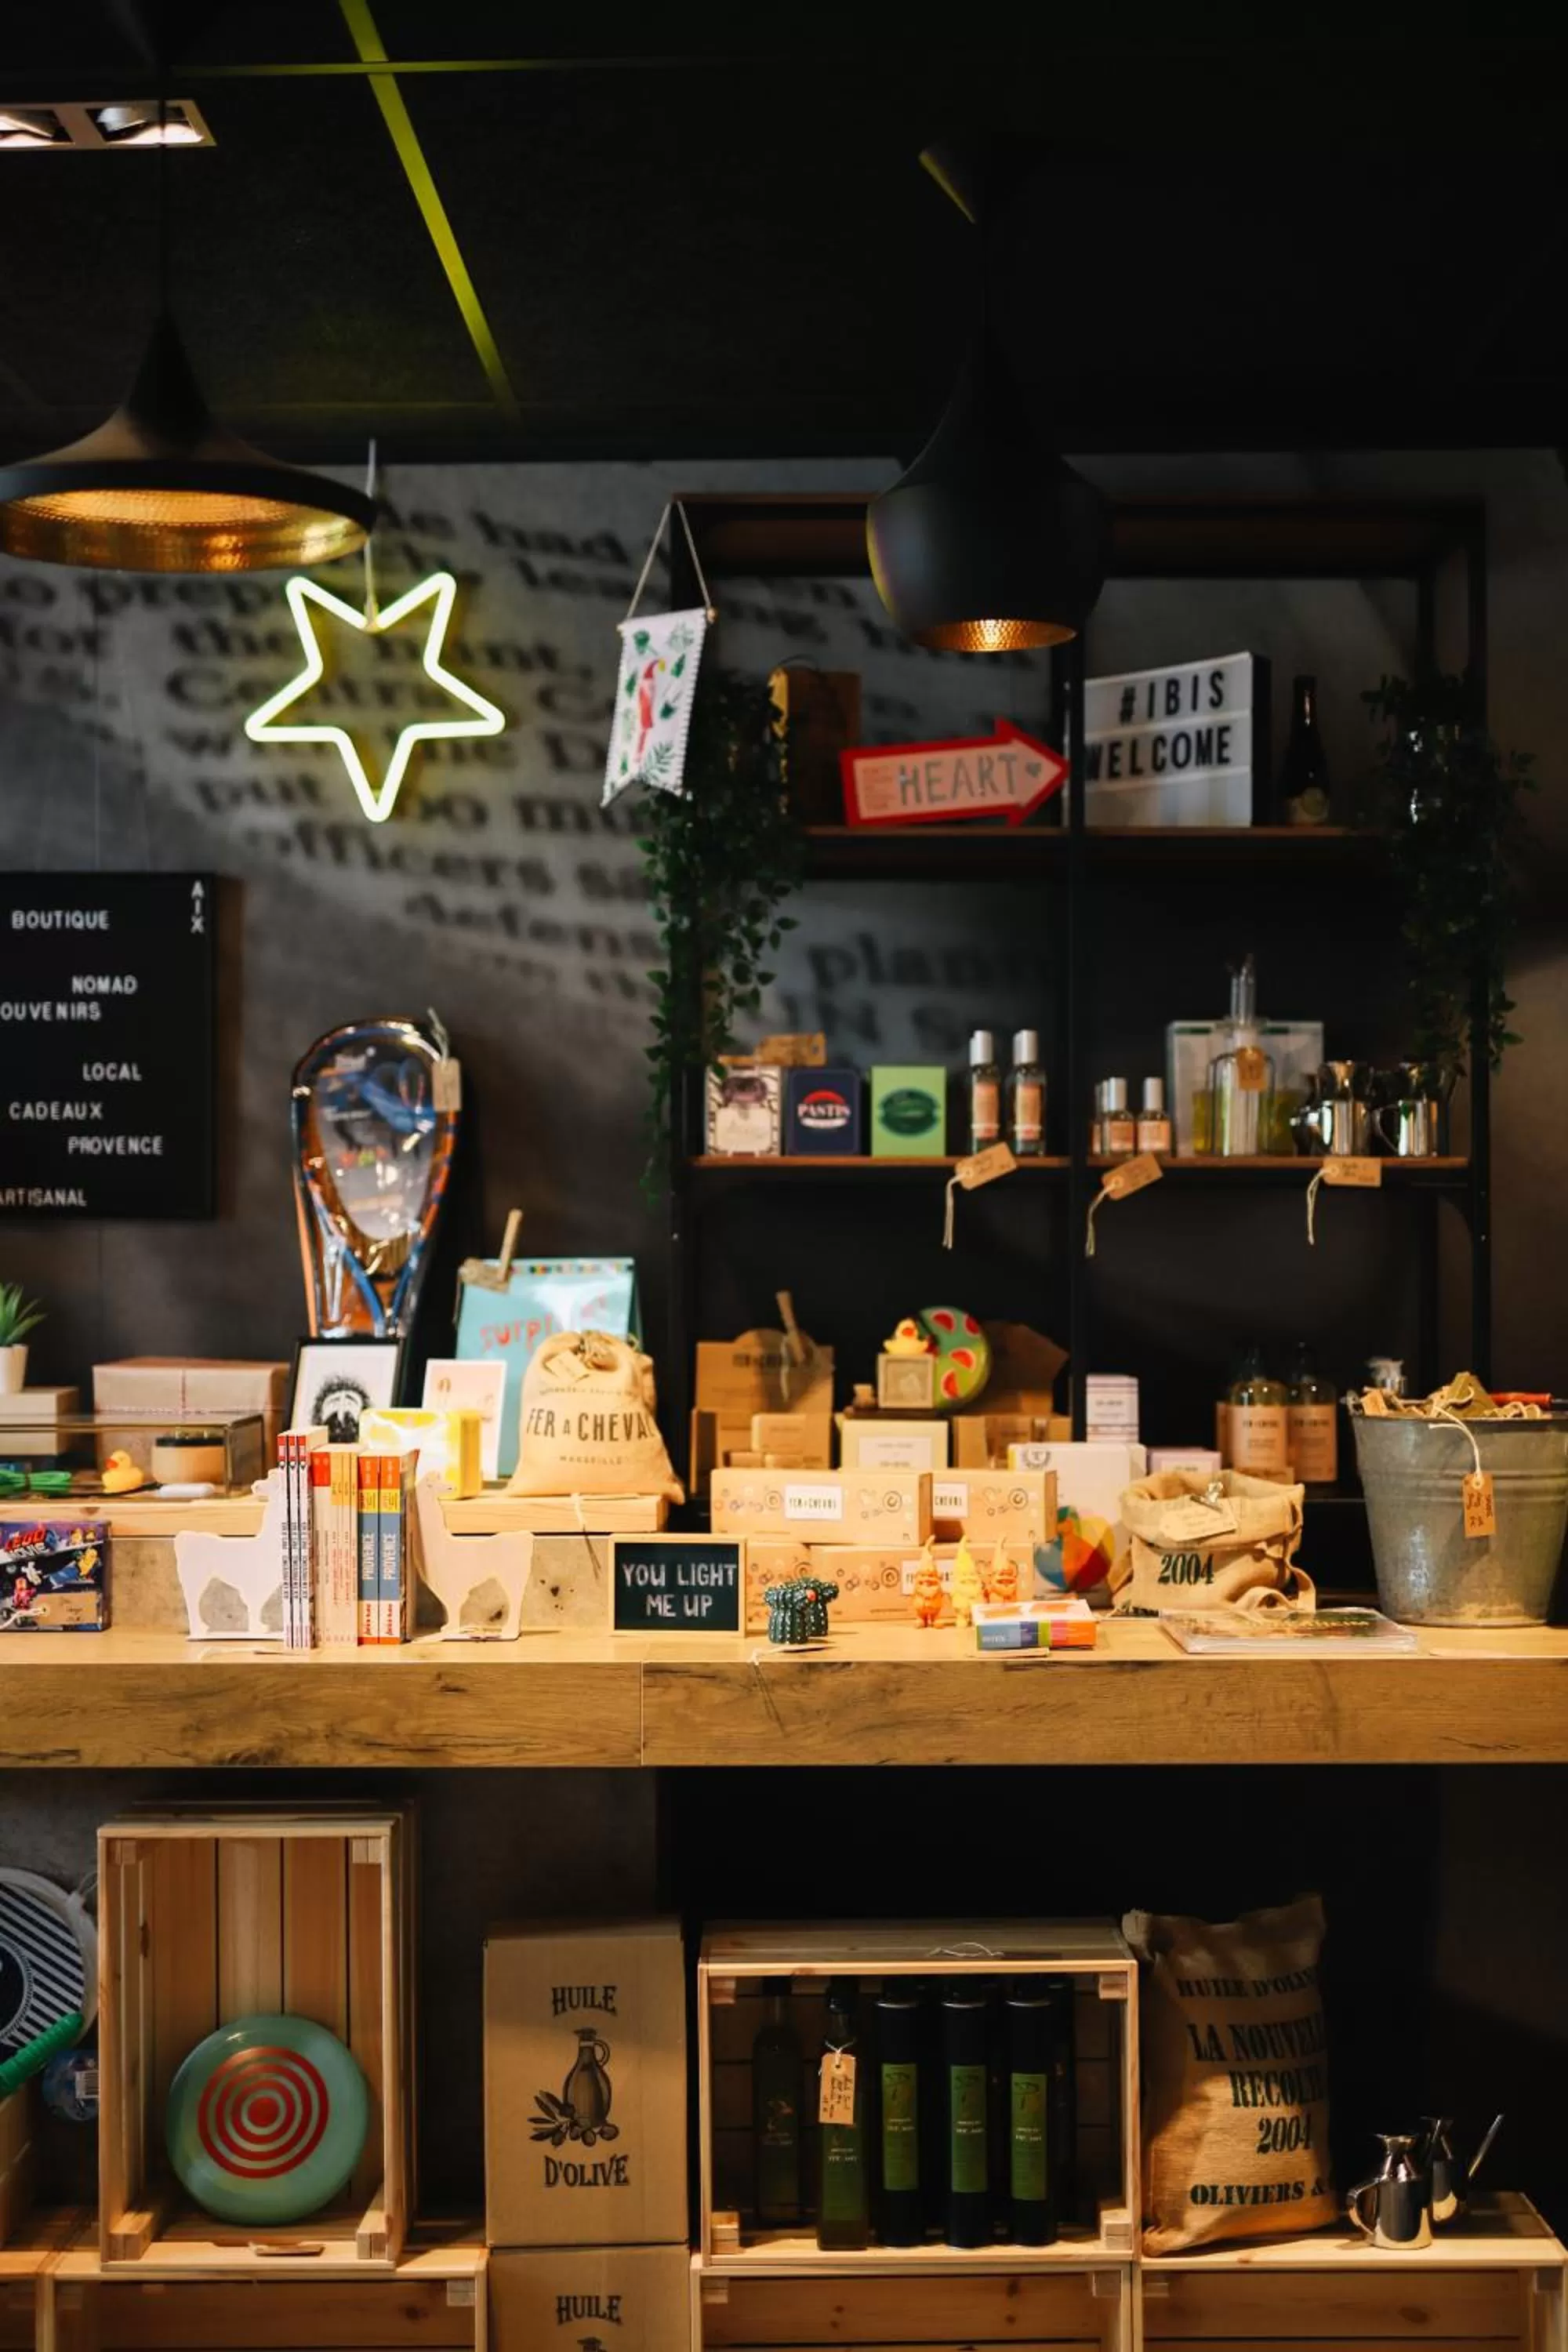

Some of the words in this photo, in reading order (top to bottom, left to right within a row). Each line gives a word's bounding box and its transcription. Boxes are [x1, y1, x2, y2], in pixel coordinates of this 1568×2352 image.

[1120, 670, 1224, 724] #IBIS
[899, 752, 1018, 806] HEART
[12, 909, 110, 930] BOUTIQUE
[191, 880, 205, 934] AIX
[71, 975, 138, 995] NOMAD
[0, 1001, 101, 1020] OUVENIRS
[82, 1062, 142, 1082] LOCAL
[9, 1101, 103, 1120] CADEAUX
[67, 1135, 163, 1155] PROVENCE
[578, 1411, 654, 1442] CHEVAL
[361, 1534, 375, 1581] PROVENCE
[383, 1534, 396, 1581] PROVENCE
[1158, 1553, 1214, 1585] 2004
[622, 1563, 666, 1588] YOU
[677, 1563, 737, 1587] LIGHT
[646, 1594, 677, 1617] ME
[683, 1594, 713, 1617] UP
[551, 1985, 617, 2017] HUILE
[1186, 2023, 1227, 2061] LA
[1258, 2113, 1312, 2154] 2004
[544, 2154, 630, 2187] D'OLIVE
[1190, 2180, 1305, 2205] OLIVIERS
[555, 2295, 624, 2326] HUILE
